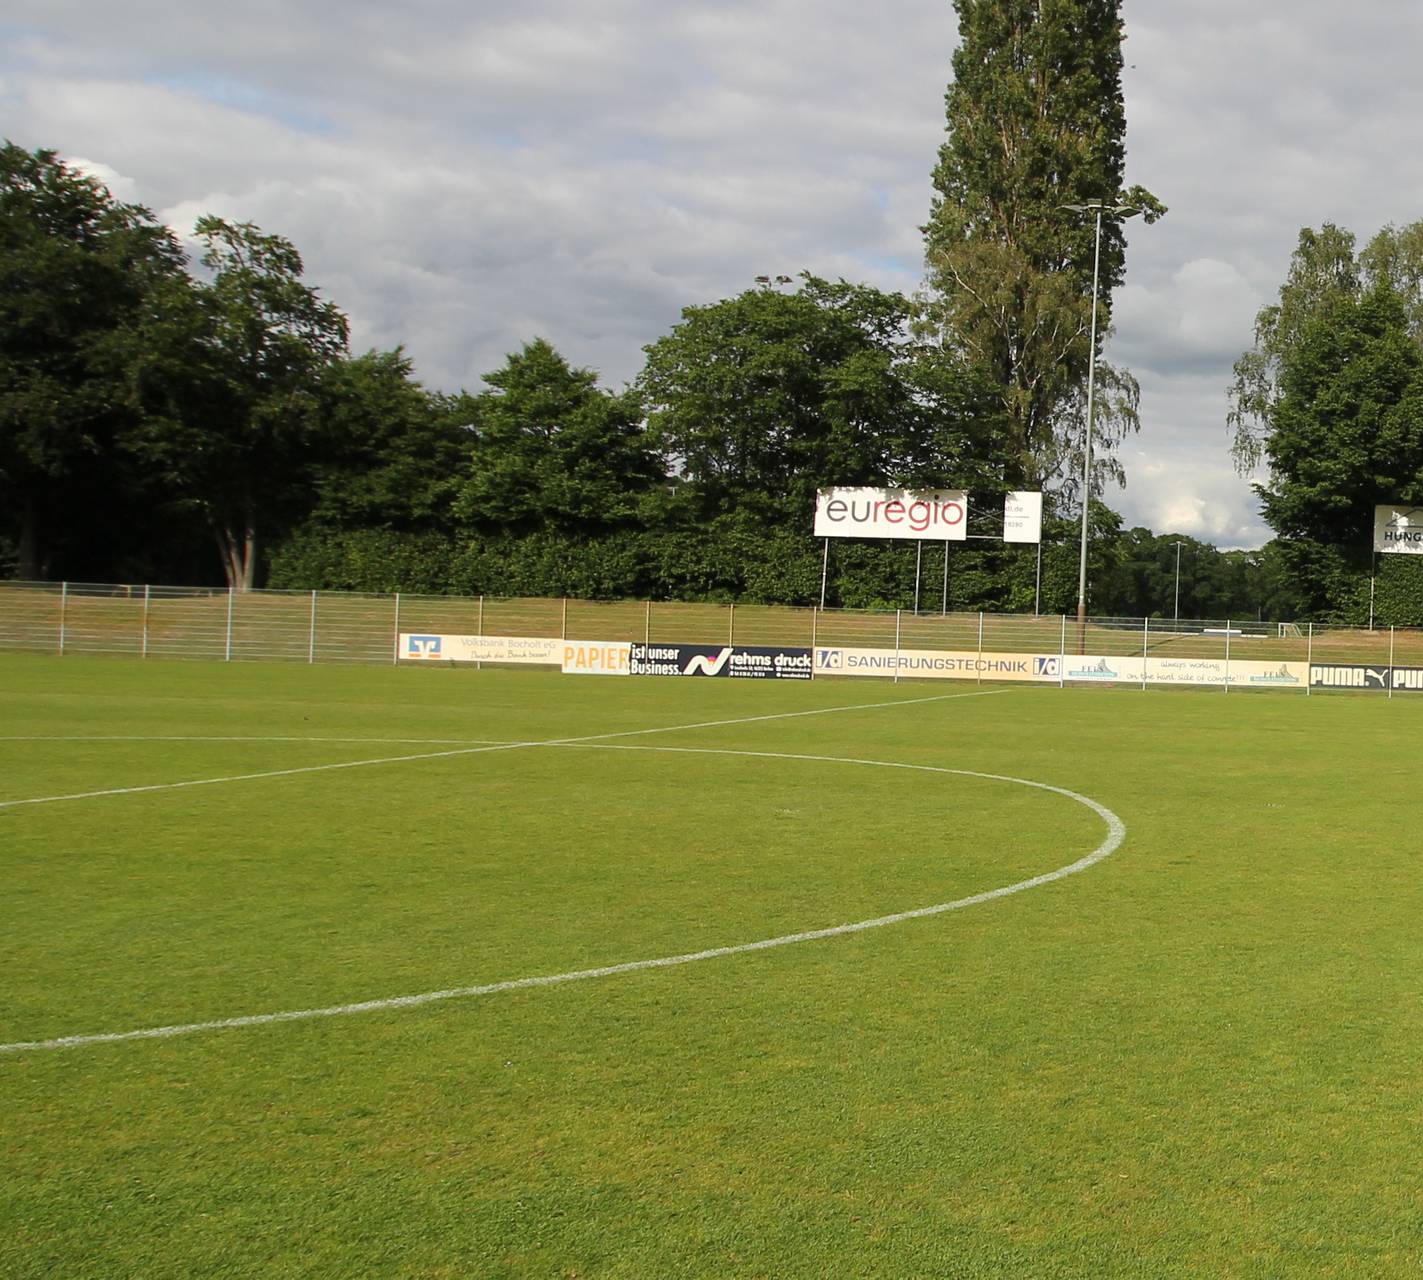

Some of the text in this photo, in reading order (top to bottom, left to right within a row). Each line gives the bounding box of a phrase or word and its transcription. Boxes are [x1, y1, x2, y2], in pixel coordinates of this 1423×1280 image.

[826, 494, 964, 531] euregio
[564, 646, 629, 670] PAPIER
[648, 648, 680, 660] unser
[730, 652, 812, 667] rehms druck
[631, 660, 683, 675] Business.
[847, 655, 1028, 673] SANIERUNGSTECHNIK
